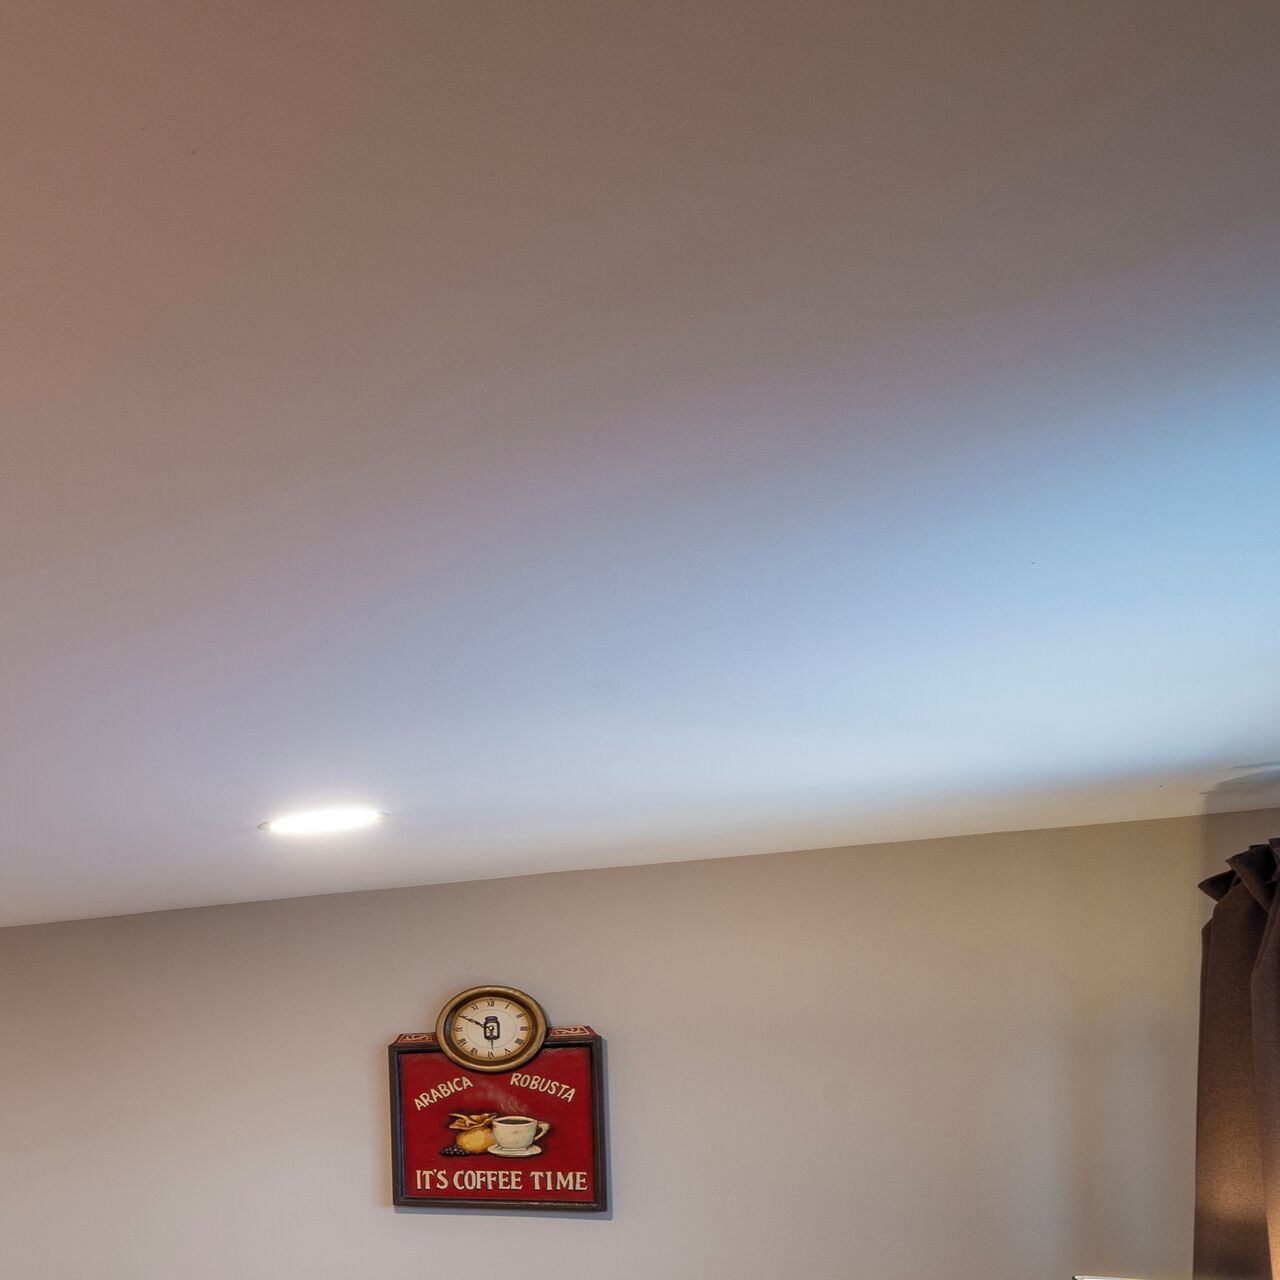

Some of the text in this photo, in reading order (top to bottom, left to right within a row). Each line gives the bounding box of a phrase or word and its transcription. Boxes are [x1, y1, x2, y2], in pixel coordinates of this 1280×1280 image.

[413, 1072, 576, 1111] ARABICA ROBUSTA
[416, 1169, 588, 1191] IT'S COFFEE TIME
